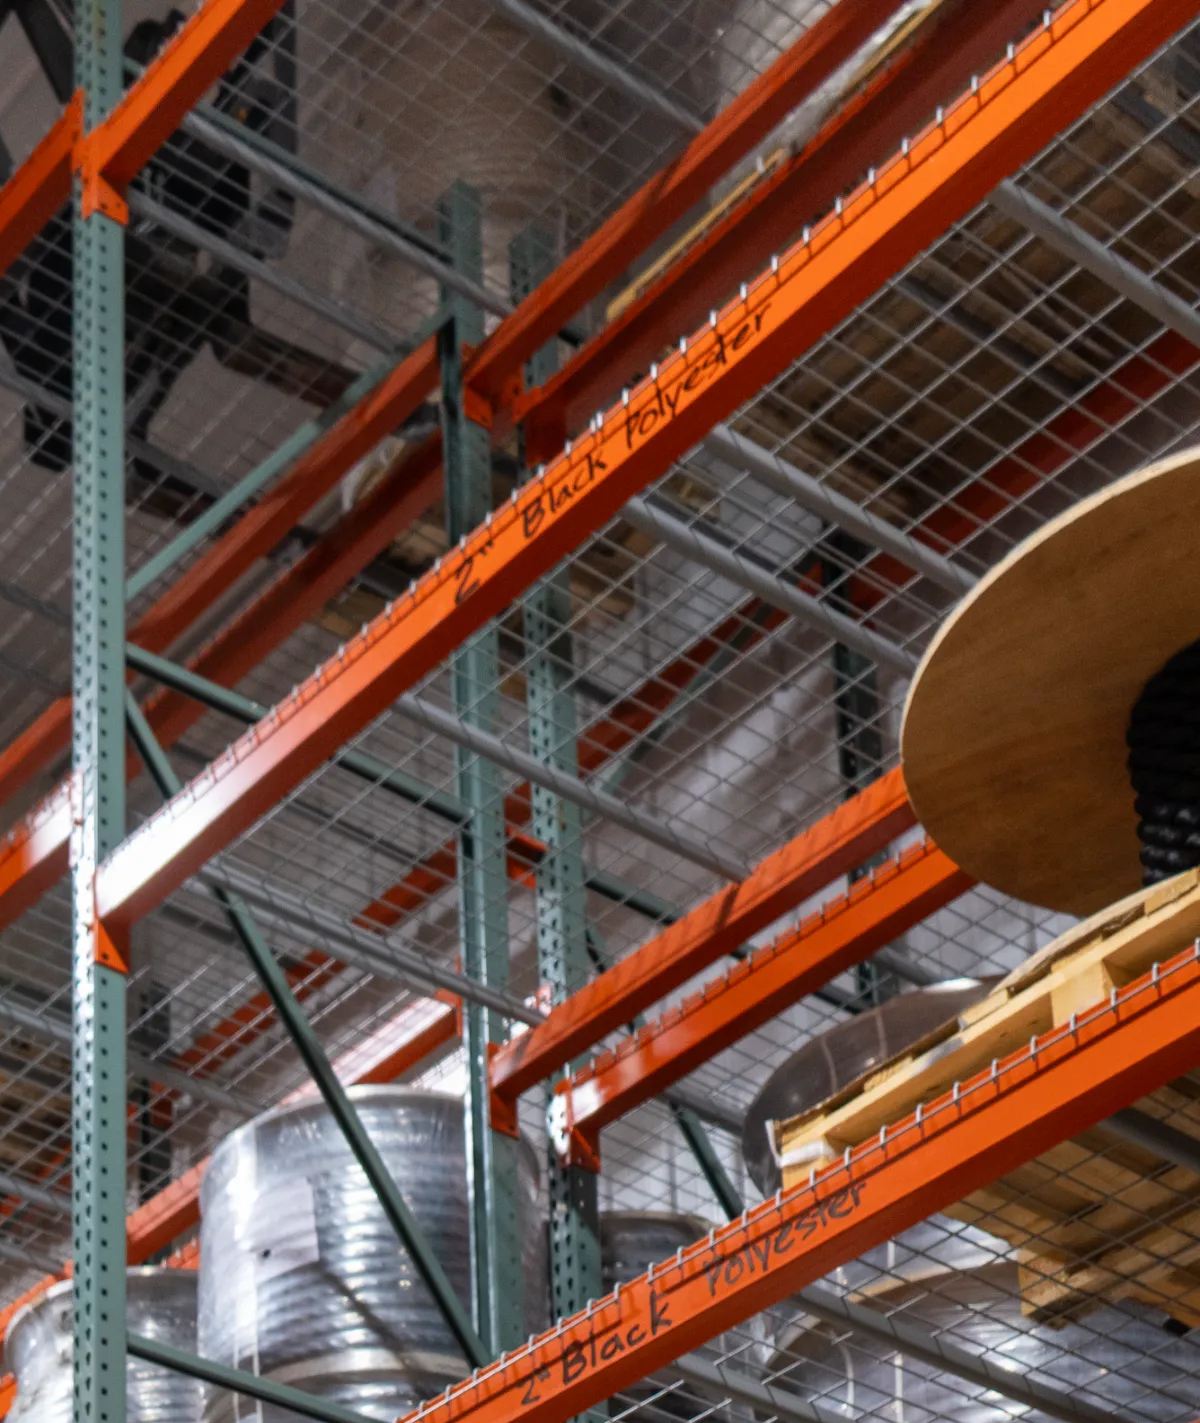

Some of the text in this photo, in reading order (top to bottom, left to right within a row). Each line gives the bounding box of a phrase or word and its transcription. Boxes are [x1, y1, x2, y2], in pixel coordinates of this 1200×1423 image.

[521, 455, 606, 539] Black
[623, 300, 772, 452] Polyester
[560, 1291, 672, 1386] Black
[702, 1182, 867, 1296] Polyester
